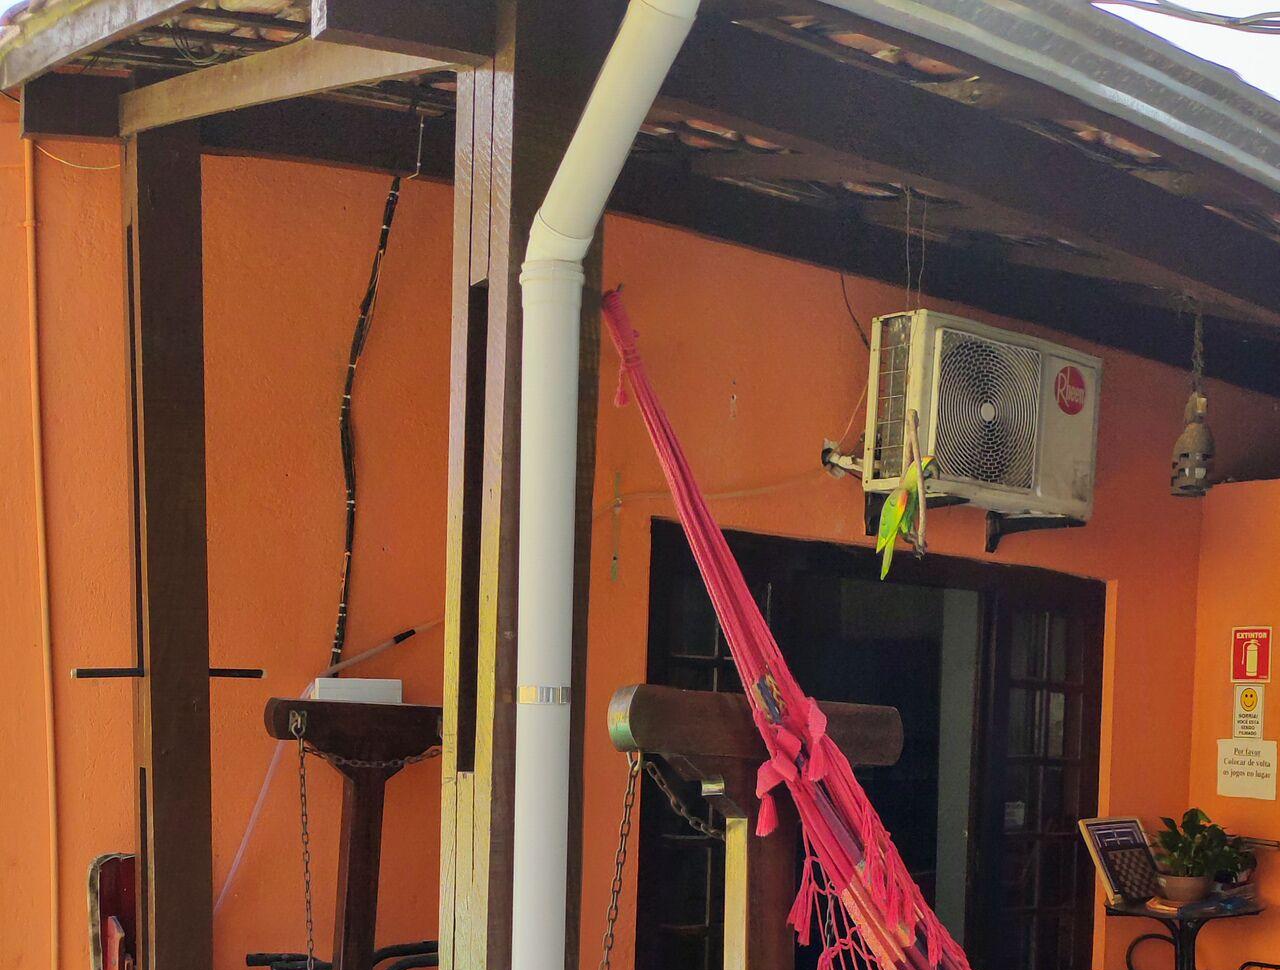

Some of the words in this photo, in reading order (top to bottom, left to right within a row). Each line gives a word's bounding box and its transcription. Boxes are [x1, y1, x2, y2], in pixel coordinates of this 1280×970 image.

[1234, 747, 1244, 755] Por
[1246, 748, 1261, 757] favor
[1223, 757, 1246, 765] Colocar
[1230, 769, 1246, 778] jogos
[1255, 770, 1271, 779] lugar
